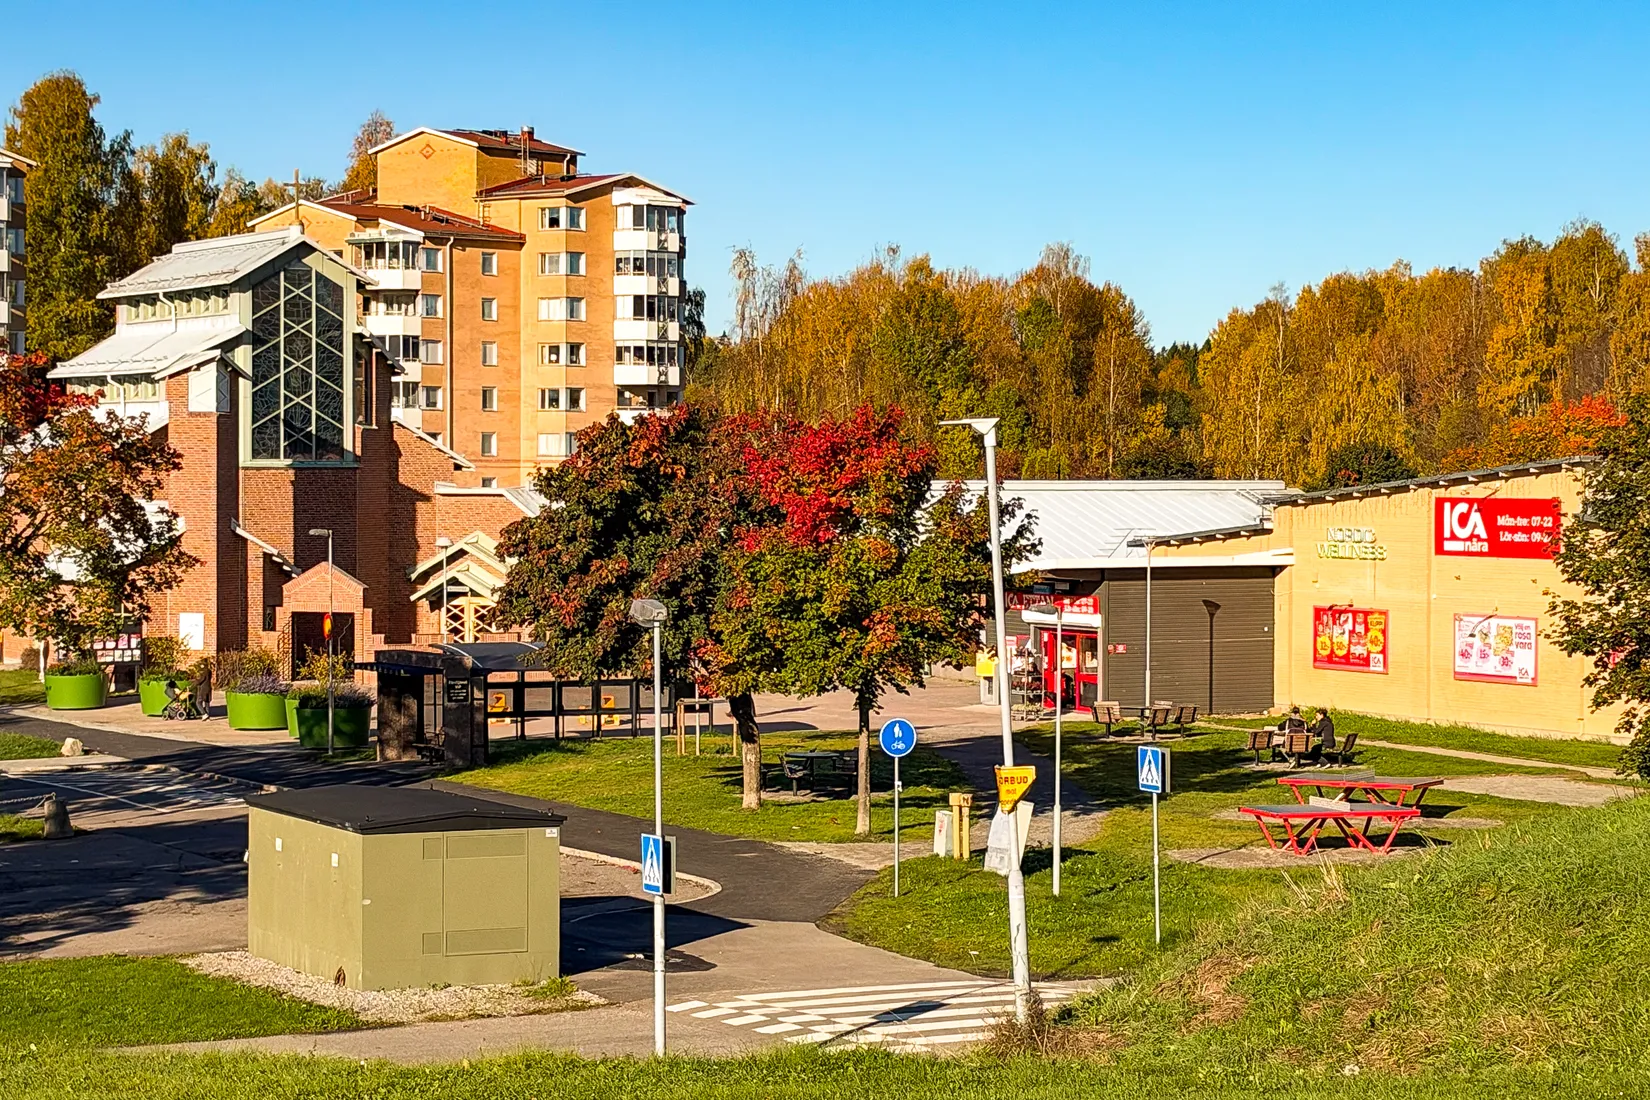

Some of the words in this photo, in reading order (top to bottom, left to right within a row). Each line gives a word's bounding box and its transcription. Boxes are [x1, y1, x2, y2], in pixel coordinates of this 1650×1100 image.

[1443, 502, 1488, 539] ICA
[1531, 516, 1553, 527] 07-22
[1327, 527, 1376, 543] NORDIC
[1316, 543, 1387, 561] WELLNESS
[1464, 539, 1488, 552] nära
[1005, 592, 1019, 608] ICA
[1515, 632, 1532, 640] rosa
[1515, 642, 1533, 650] vara
[1518, 667, 1529, 676] ICA
